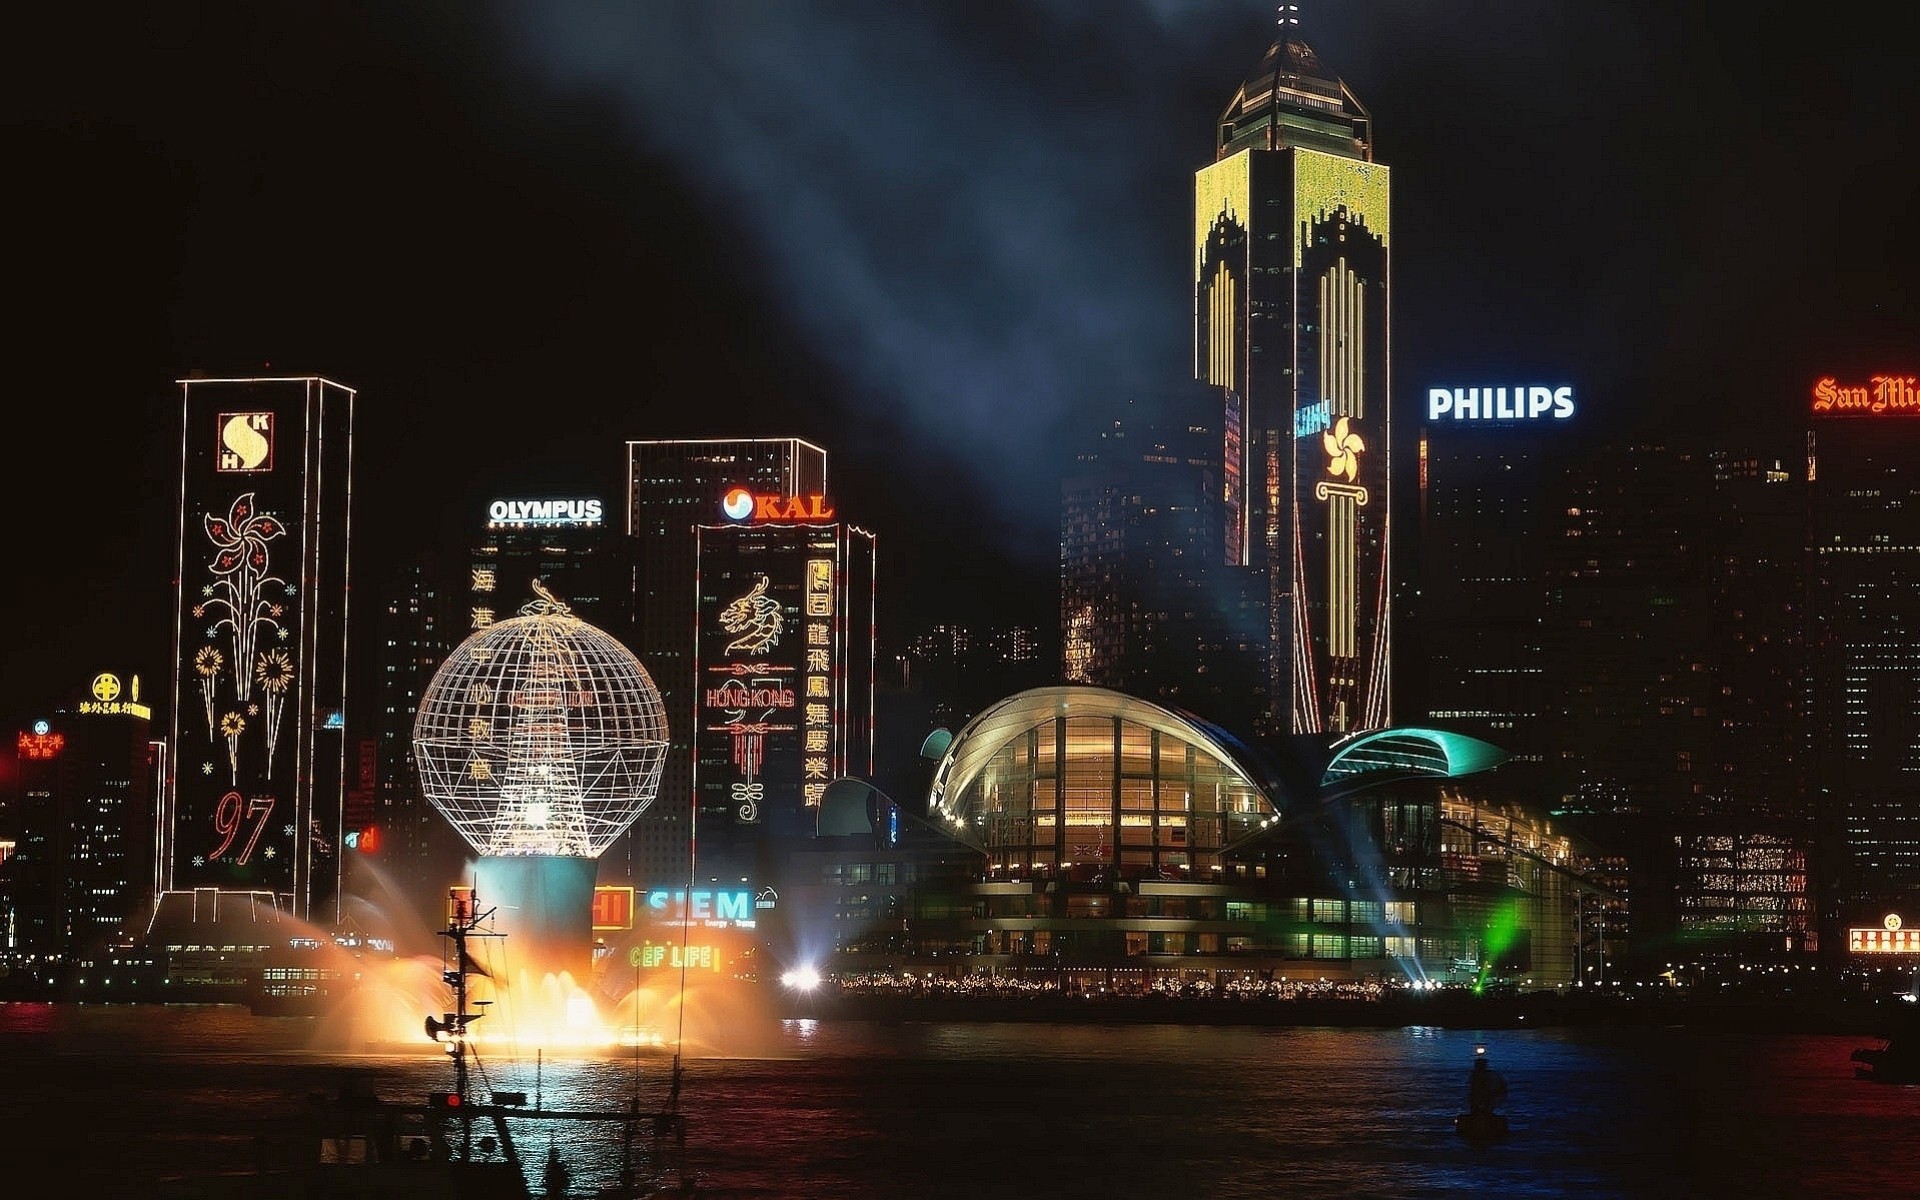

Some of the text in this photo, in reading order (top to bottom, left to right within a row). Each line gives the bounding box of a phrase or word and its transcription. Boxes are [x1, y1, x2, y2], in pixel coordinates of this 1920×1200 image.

[1429, 387, 1575, 420] PHILIPS
[1814, 376, 1920, 412] San Mi
[489, 500, 602, 519] OLYMPUS
[755, 495, 833, 519] KAL
[706, 688, 795, 708] HONG KONG
[209, 791, 275, 866] 97
[629, 946, 665, 968] CEF
[671, 946, 711, 968] LIFE
